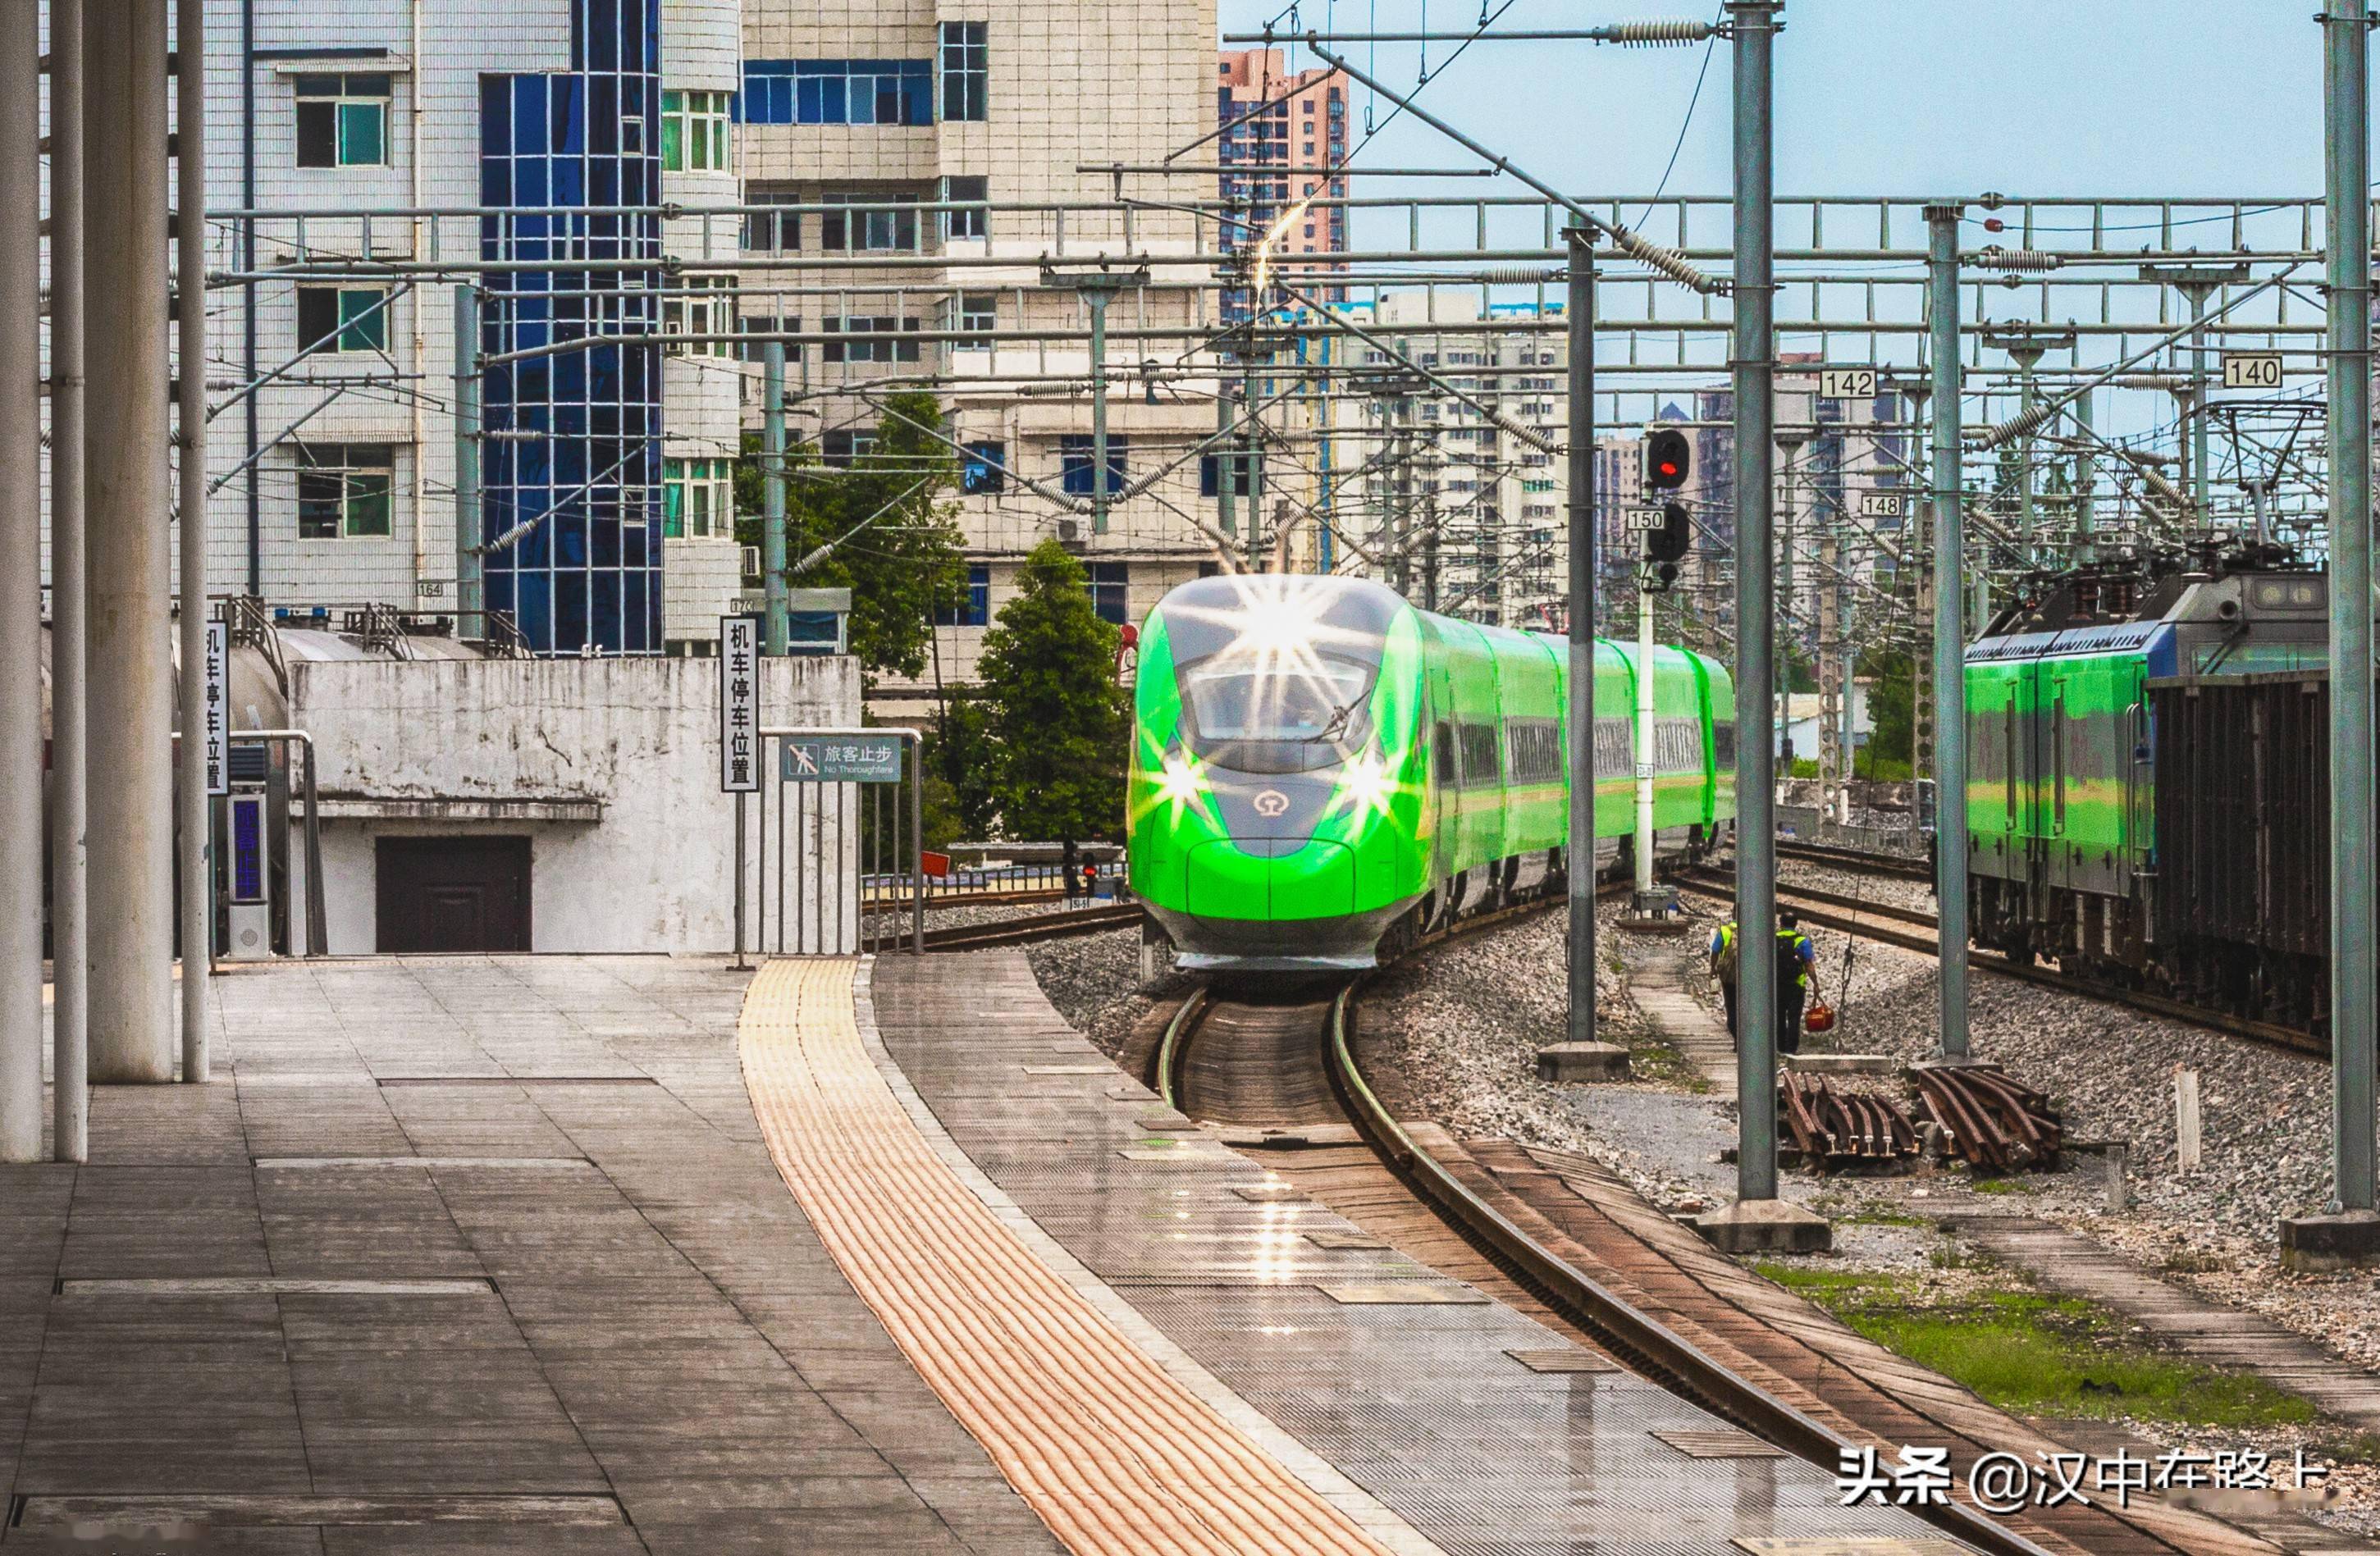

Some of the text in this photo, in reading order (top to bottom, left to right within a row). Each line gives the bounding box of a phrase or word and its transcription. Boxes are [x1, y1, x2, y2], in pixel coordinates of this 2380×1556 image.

[2232, 360, 2277, 384] 140
[1827, 372, 1872, 395] 142
[1866, 497, 1898, 514] 148
[1631, 512, 1663, 527] 150
[419, 583, 441, 595] 164
[730, 623, 750, 783] 机车停车位置
[825, 745, 893, 763] 旅客止步
[824, 765, 837, 773] No
